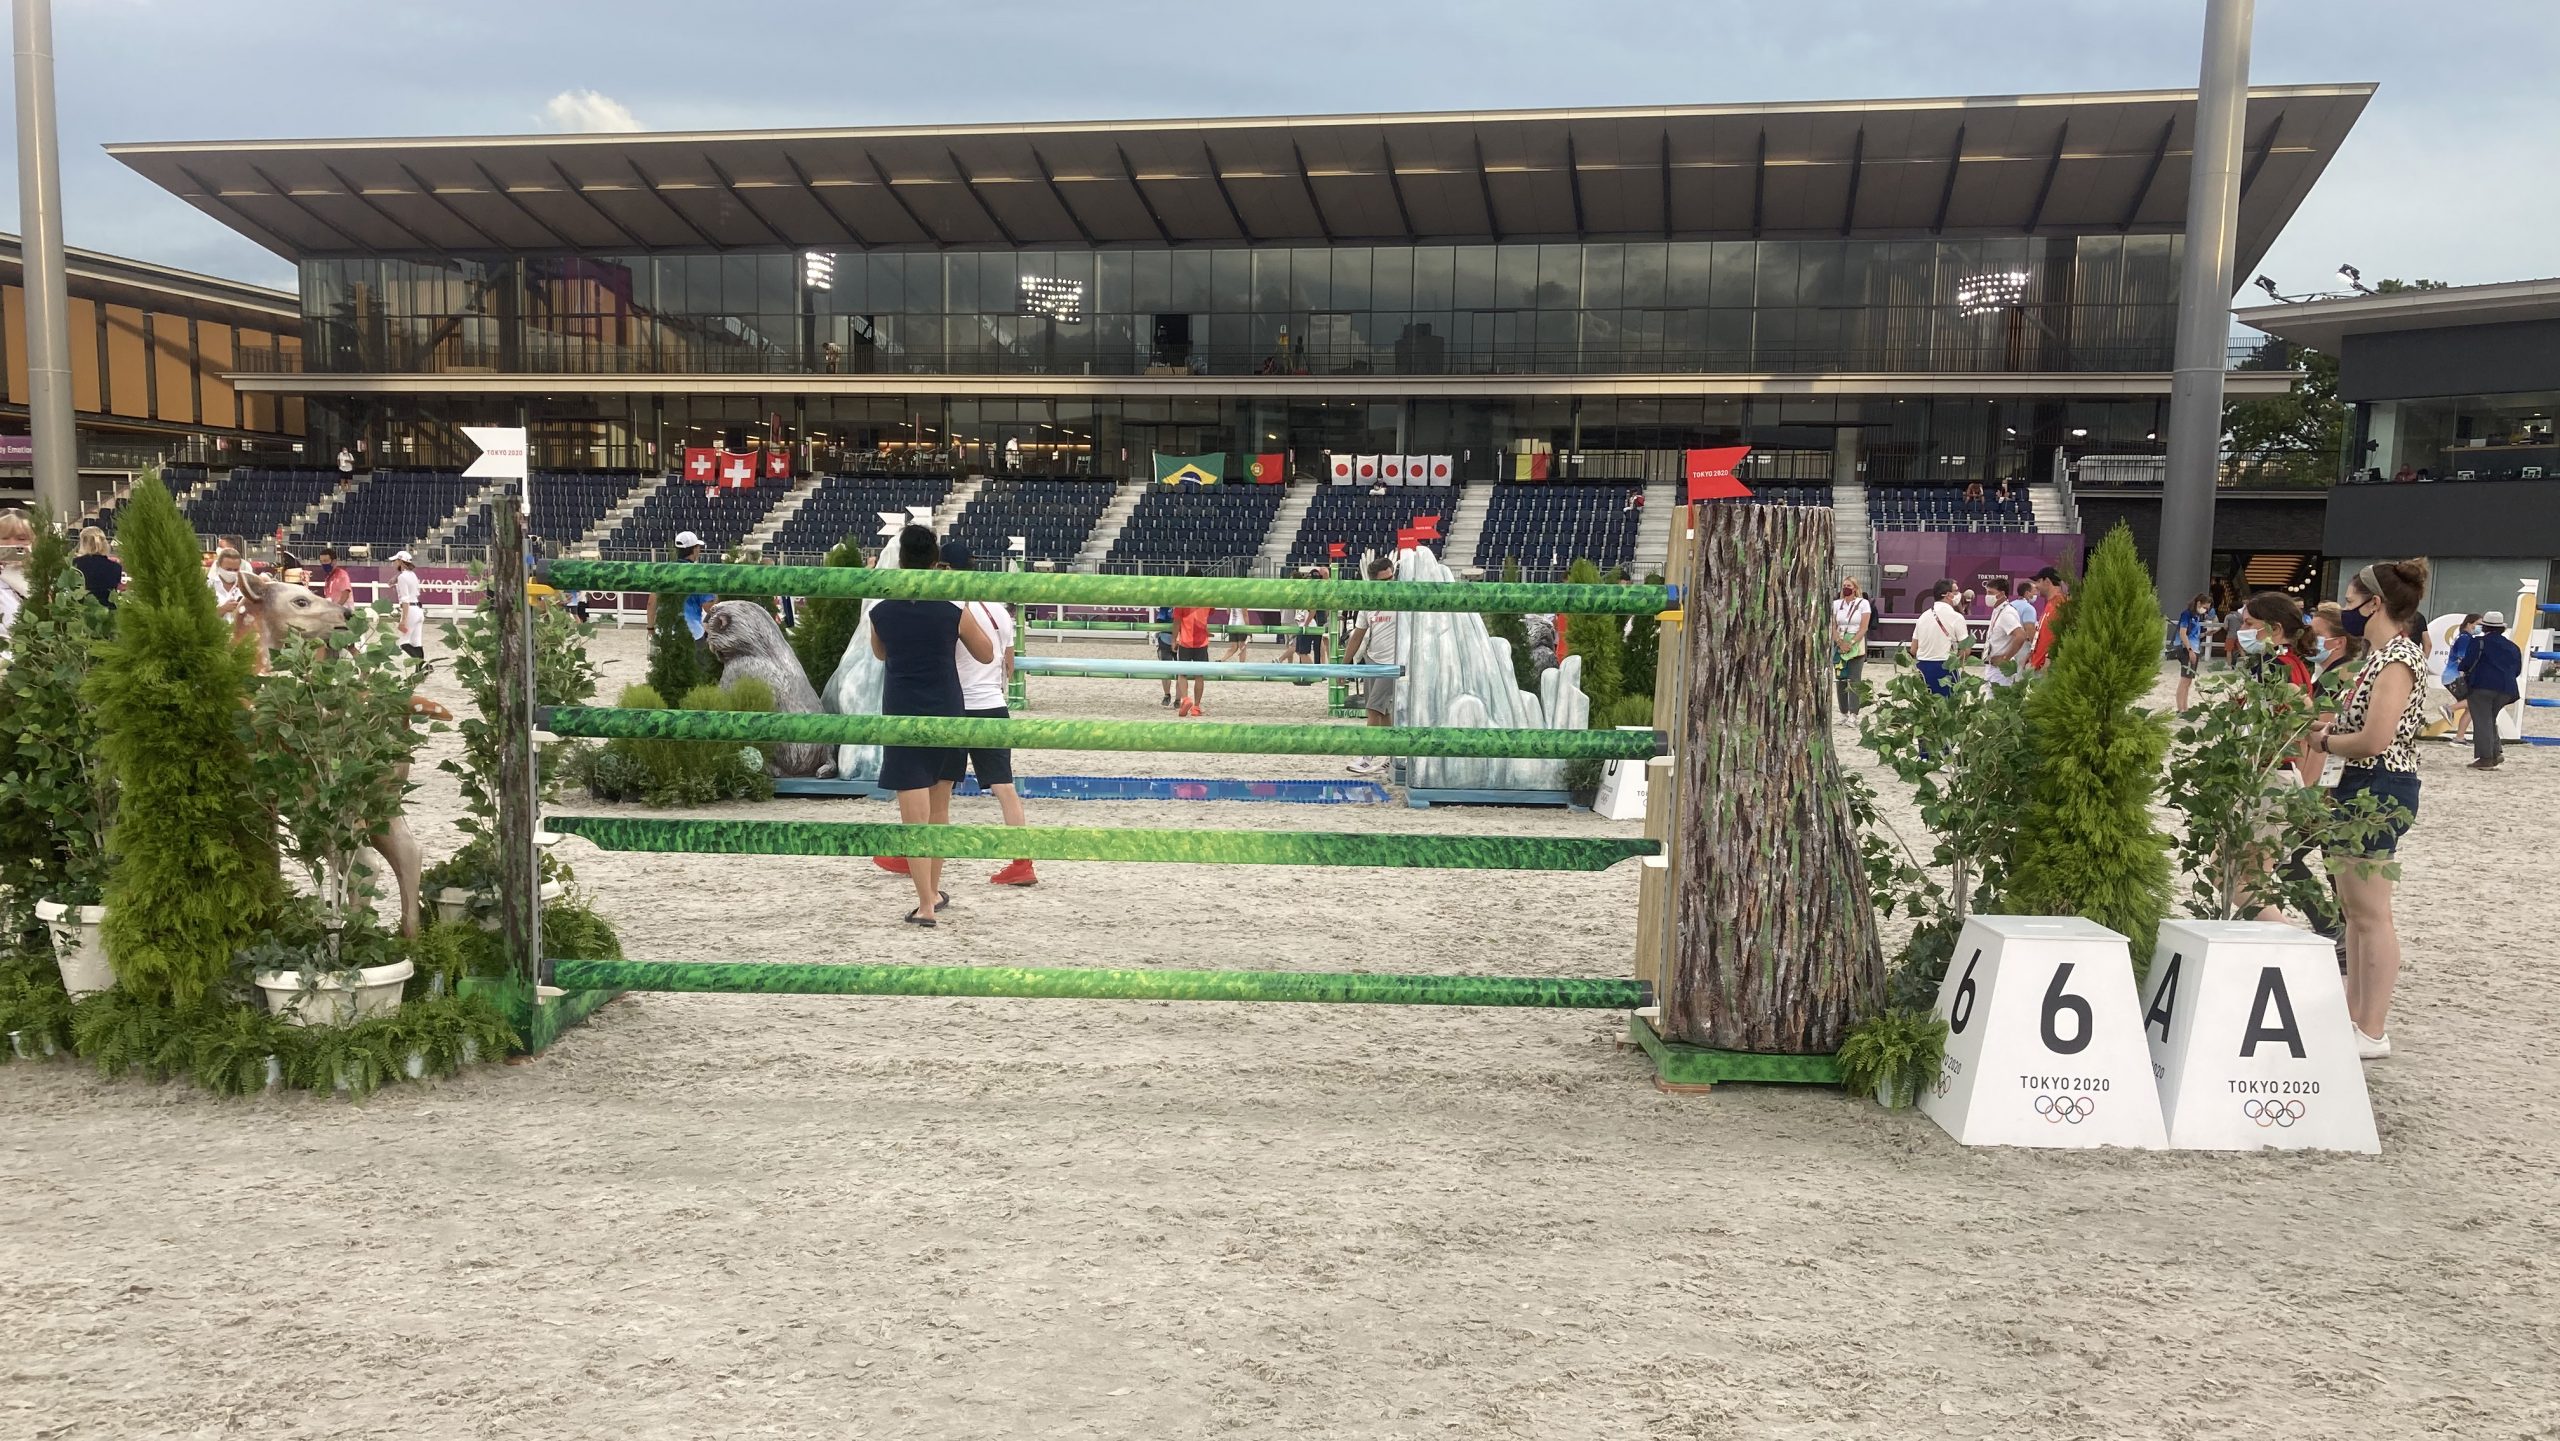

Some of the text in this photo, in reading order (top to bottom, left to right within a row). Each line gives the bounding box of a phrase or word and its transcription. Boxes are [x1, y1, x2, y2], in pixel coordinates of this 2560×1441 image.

[1692, 469, 1729, 478] TOKYO 2020
[1951, 948, 1982, 1035] 6
[2041, 962, 2093, 1055] 6
[2145, 952, 2182, 1044] A
[2239, 966, 2307, 1059] A
[1948, 1057, 1962, 1075] 2020
[2020, 1075, 2110, 1092] TOKYO 2020
[2227, 1080, 2320, 1095] TOKYO 2020
